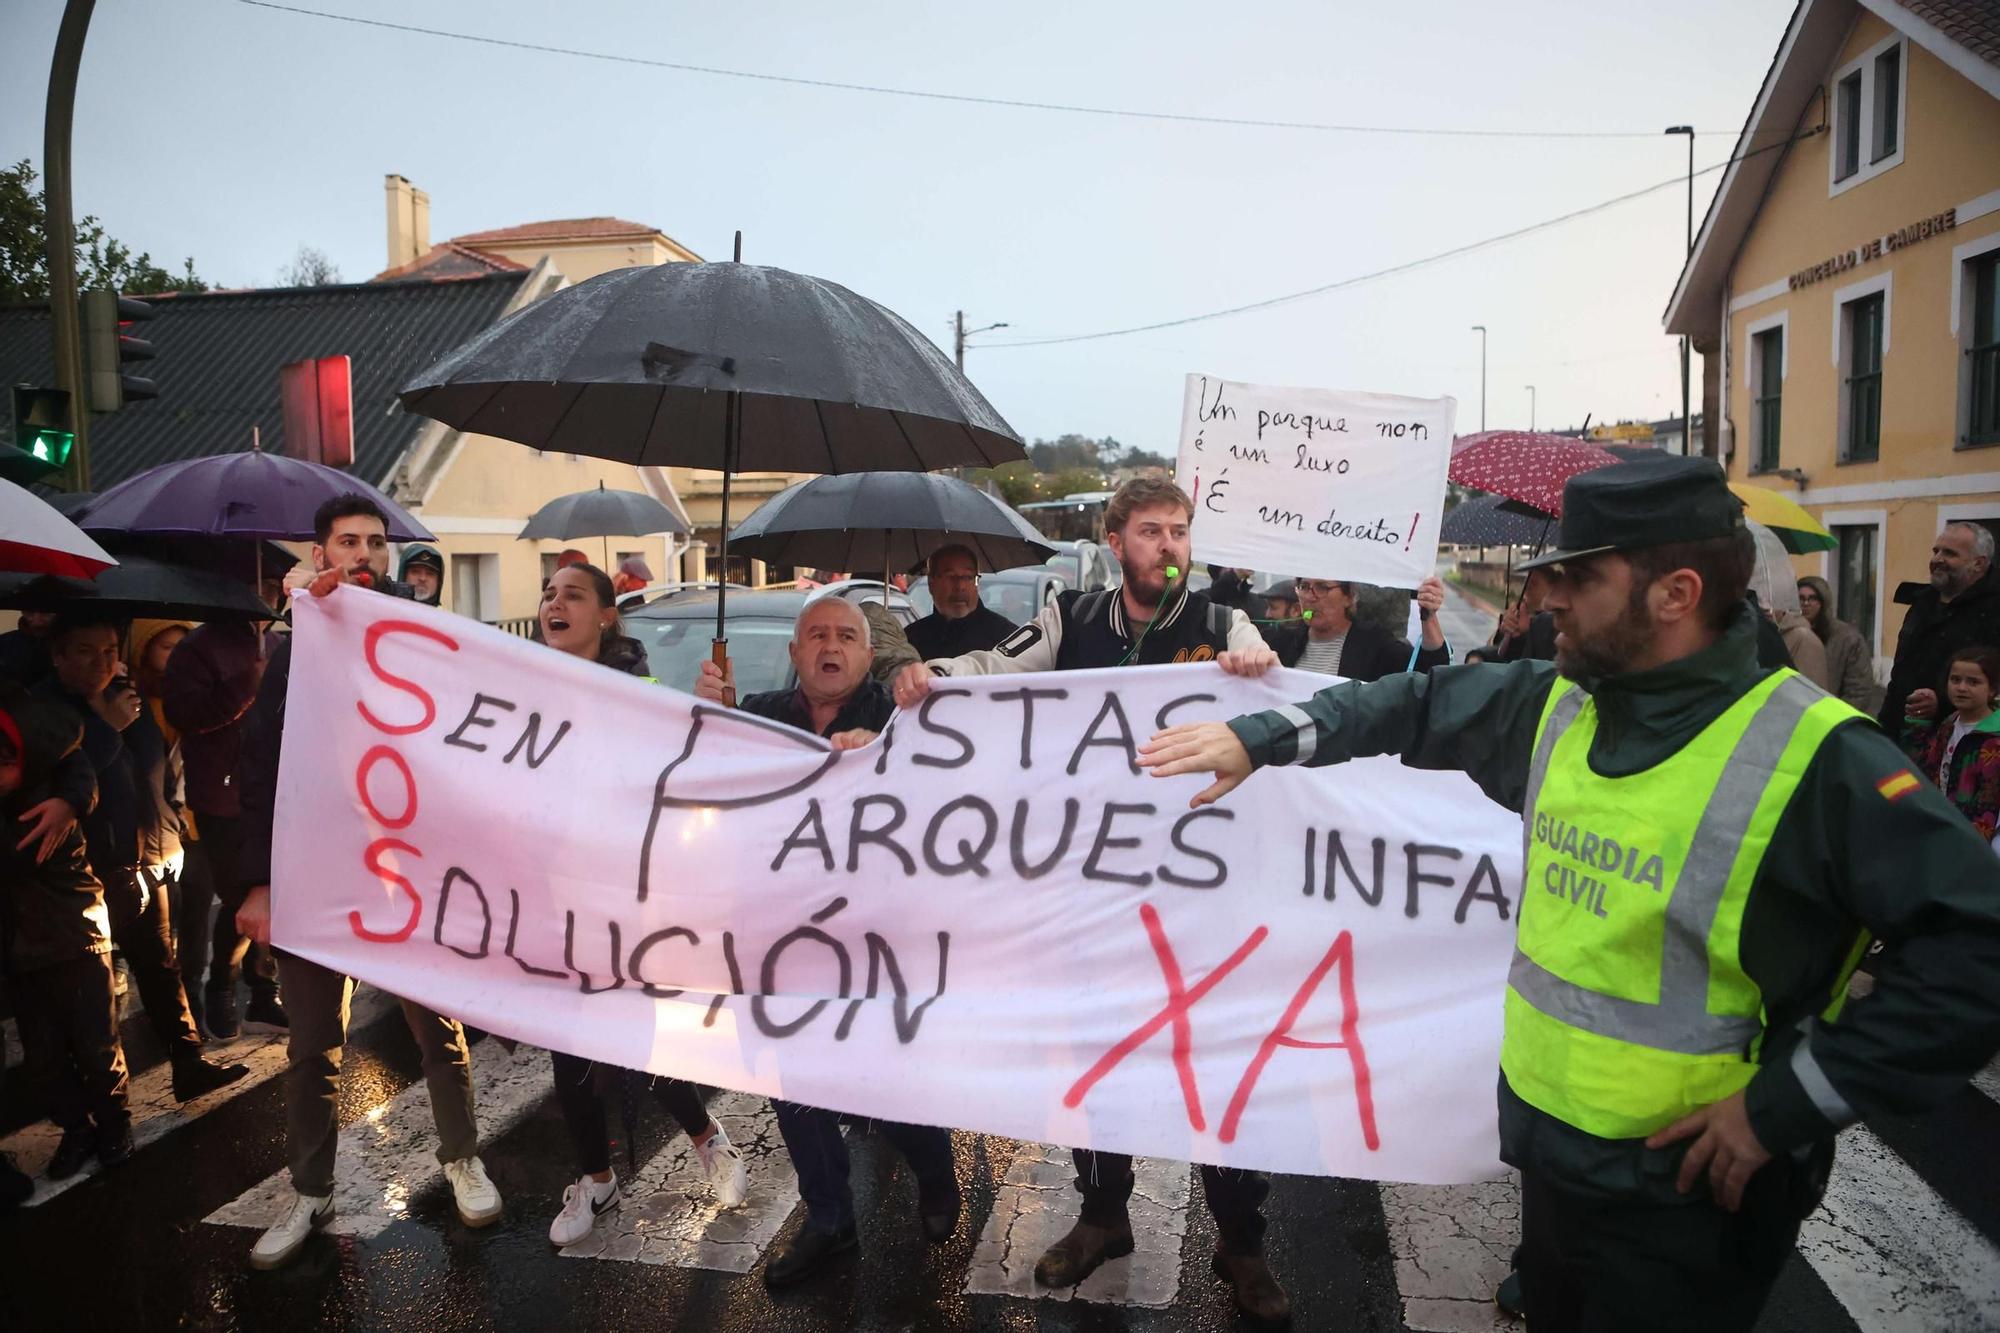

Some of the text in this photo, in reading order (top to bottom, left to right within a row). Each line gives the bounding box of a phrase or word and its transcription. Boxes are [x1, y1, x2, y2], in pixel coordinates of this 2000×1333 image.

[1788, 207, 1957, 291] CONCELLO DE CAMBRE
[1198, 376, 1429, 441] Un parque non
[1194, 429, 1351, 474] é un luxo
[1258, 504, 1305, 533] un
[1535, 811, 1665, 893] GUARDIA
[1544, 861, 1609, 919] CIVIL
[1063, 902, 1382, 1153] XA
